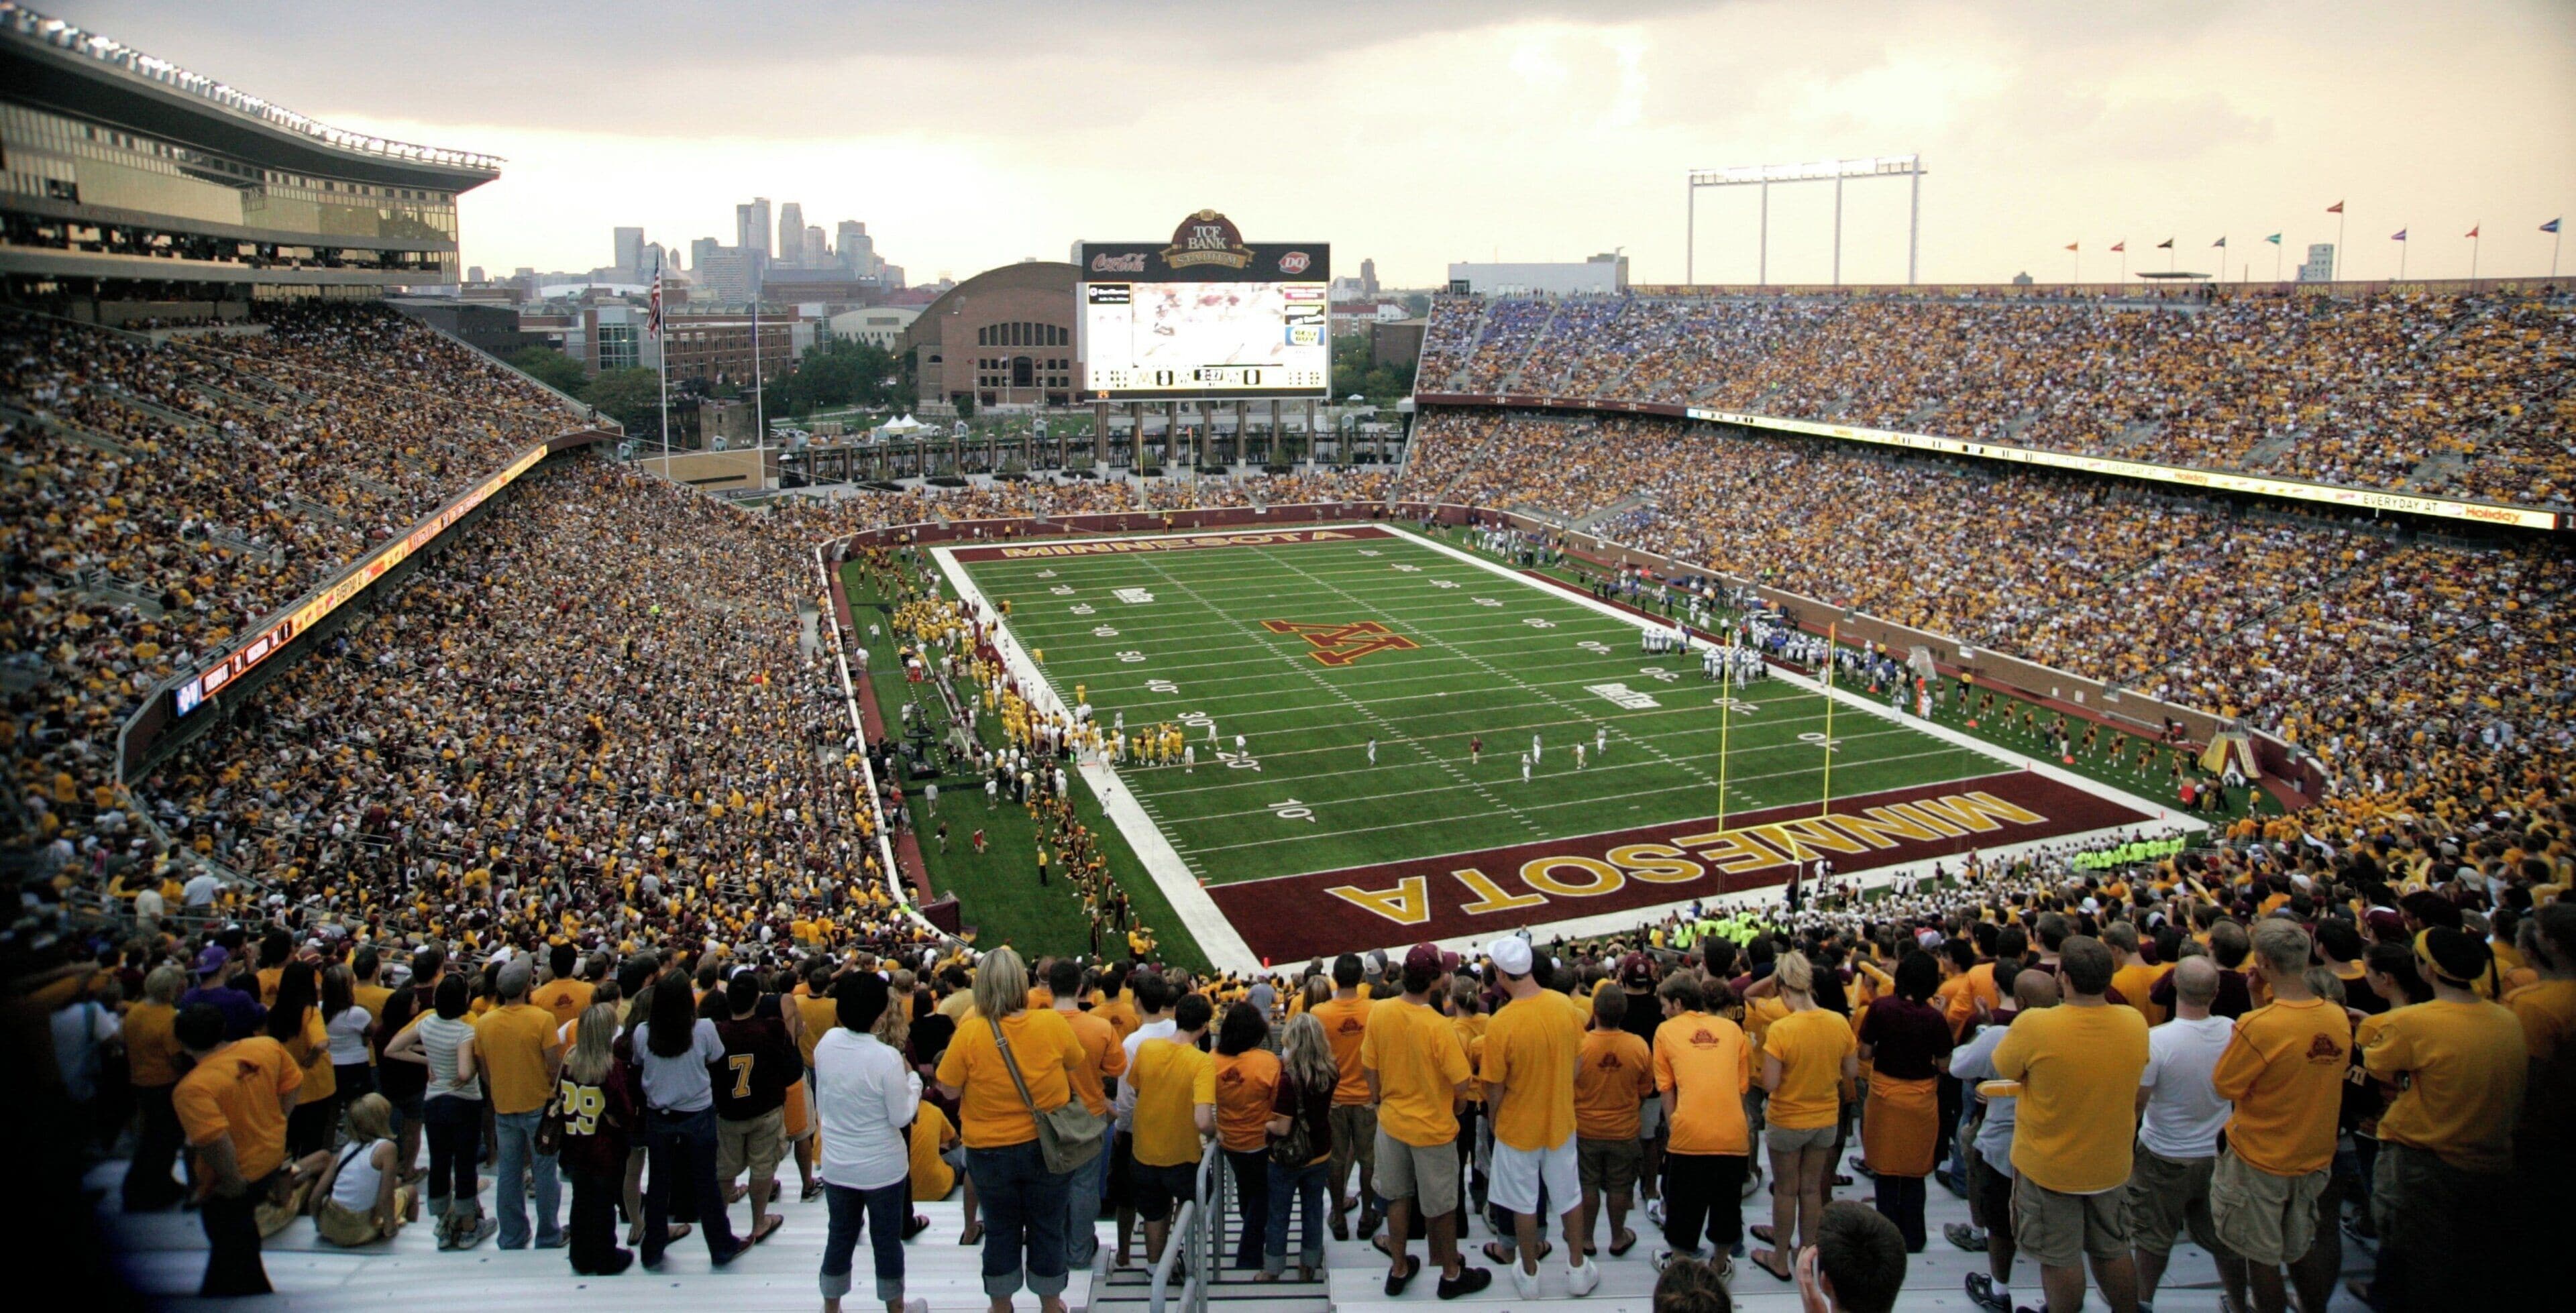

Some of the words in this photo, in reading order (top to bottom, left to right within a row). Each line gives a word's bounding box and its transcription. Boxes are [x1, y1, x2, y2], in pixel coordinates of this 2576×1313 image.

[1193, 225, 1222, 239] TCF
[1188, 237, 1228, 250] BANK
[1177, 251, 1238, 266] STADIUM
[1284, 257, 1306, 268] DQ
[2363, 494, 2421, 512] EVERYDAY
[2424, 502, 2438, 513] AT
[2466, 506, 2522, 524] Holiday
[1000, 530, 1356, 559] MINNESOTA
[1115, 650, 1146, 662] 50
[1144, 679, 1179, 694] 40
[1177, 711, 1214, 726] 30
[1215, 750, 1259, 768] 20
[1268, 799, 1313, 819] 10
[1323, 791, 2049, 925] MINNESOTA
[729, 1053, 754, 1098] 7
[561, 1078, 606, 1136] 29
